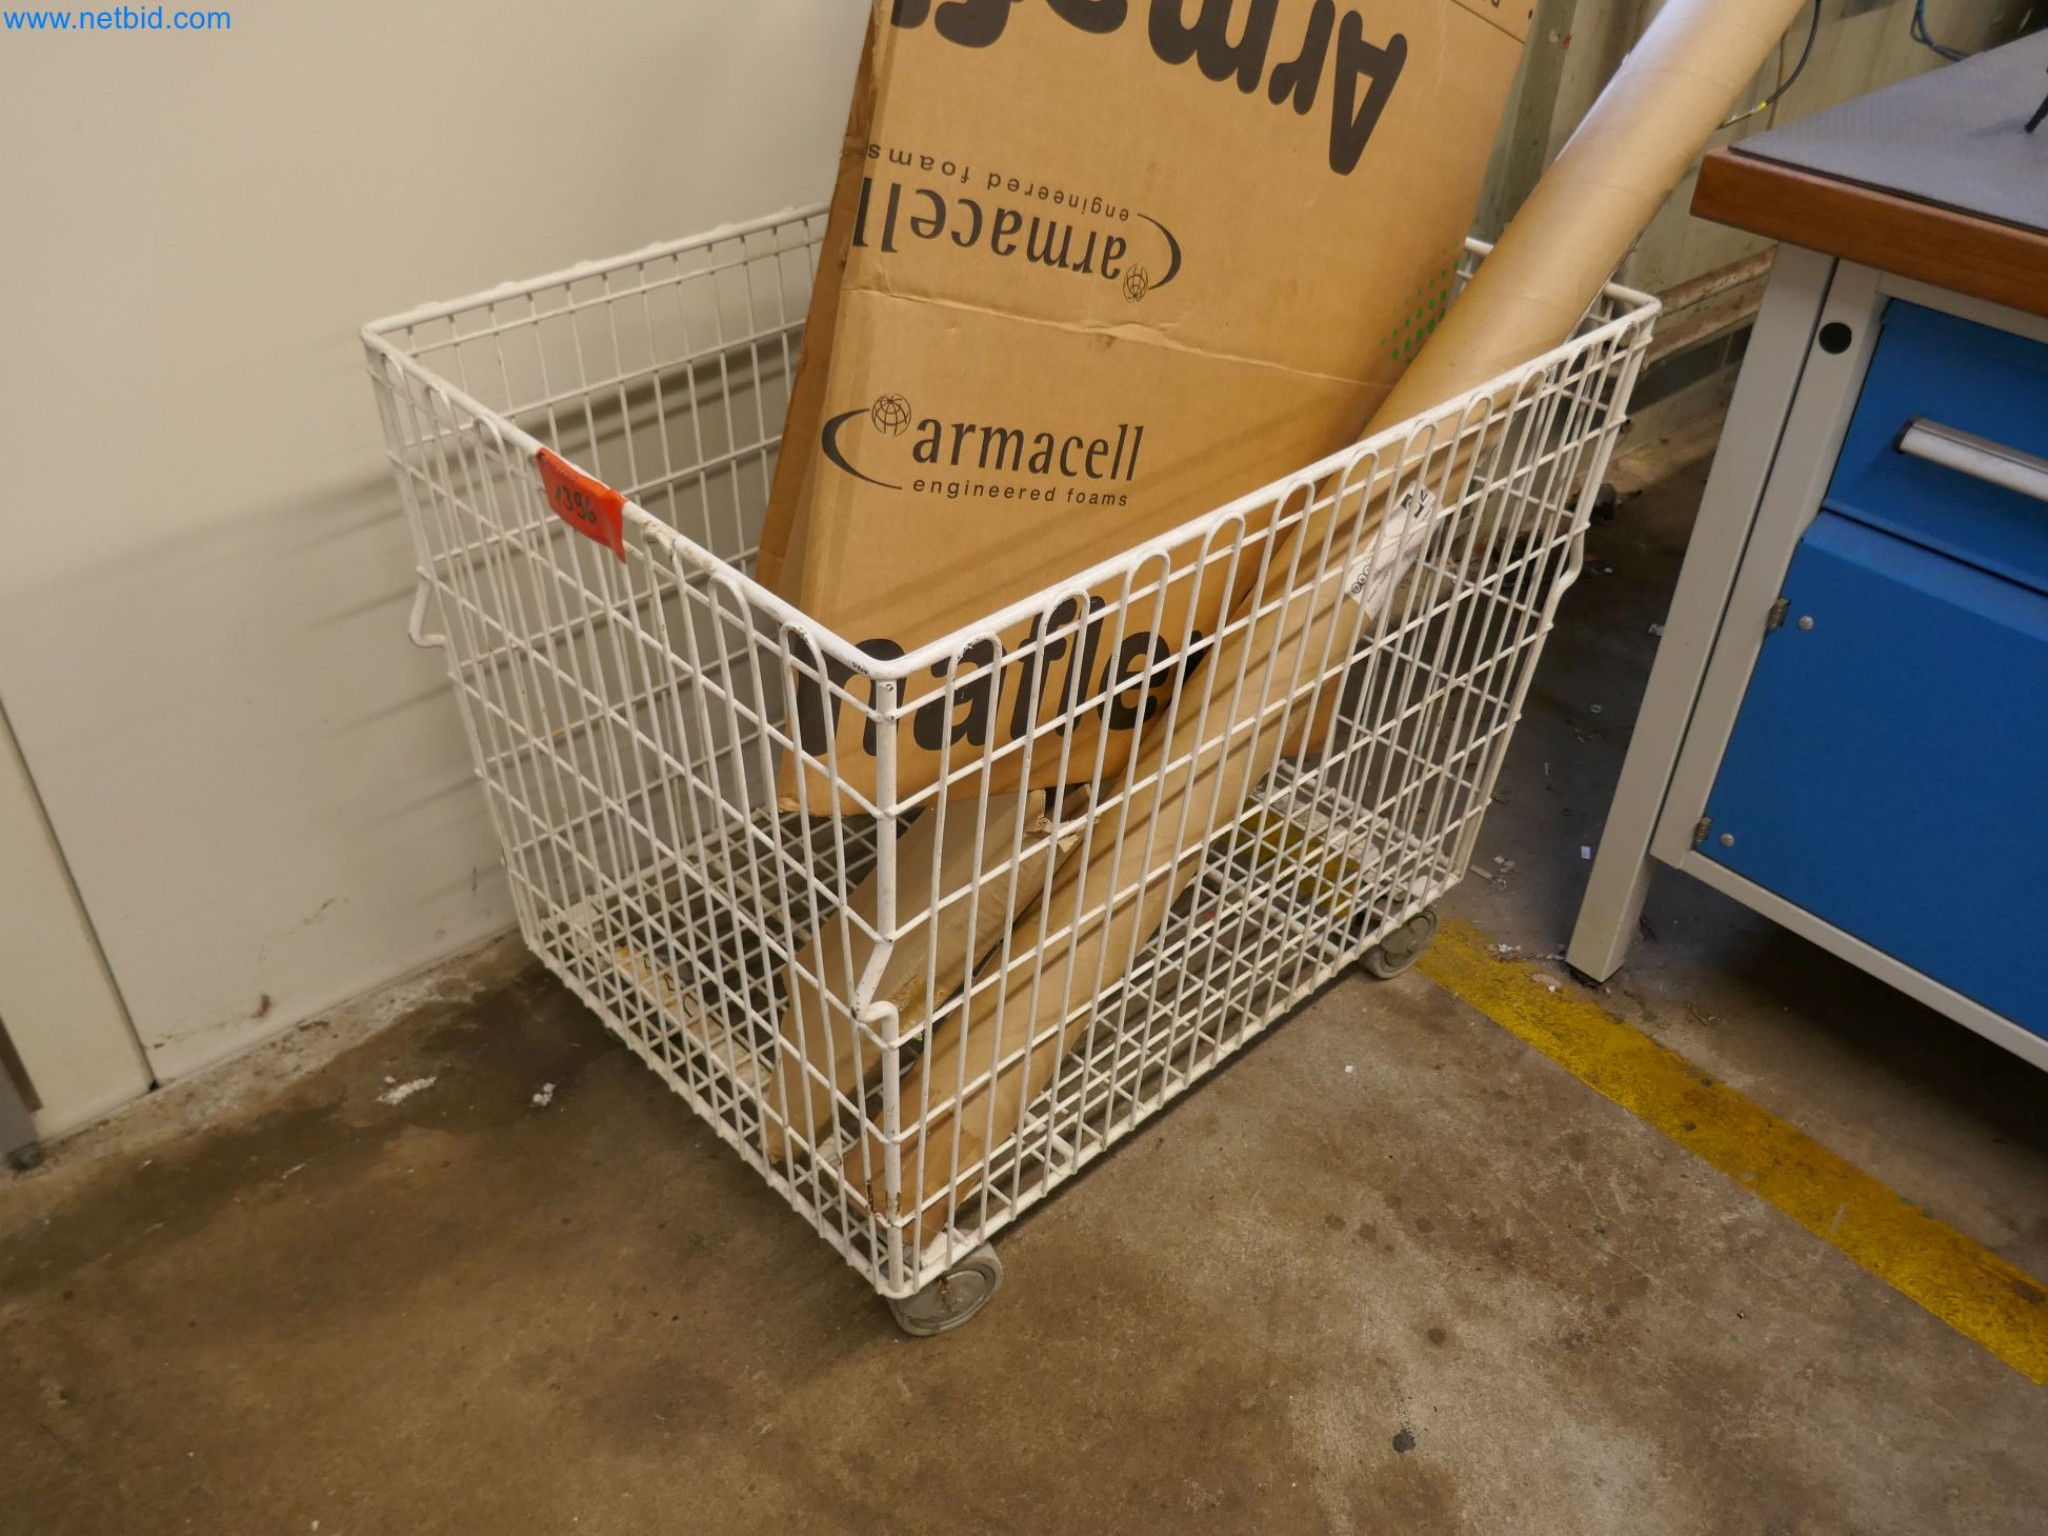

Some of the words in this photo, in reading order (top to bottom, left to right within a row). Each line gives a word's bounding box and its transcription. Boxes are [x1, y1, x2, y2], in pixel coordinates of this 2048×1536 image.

[867, 143, 970, 183] foams
[987, 171, 1129, 222] engineered
[852, 176, 1127, 281] armacell
[911, 416, 1145, 482] armacell
[912, 479, 1056, 502] engineered
[1066, 487, 1129, 507] foams
